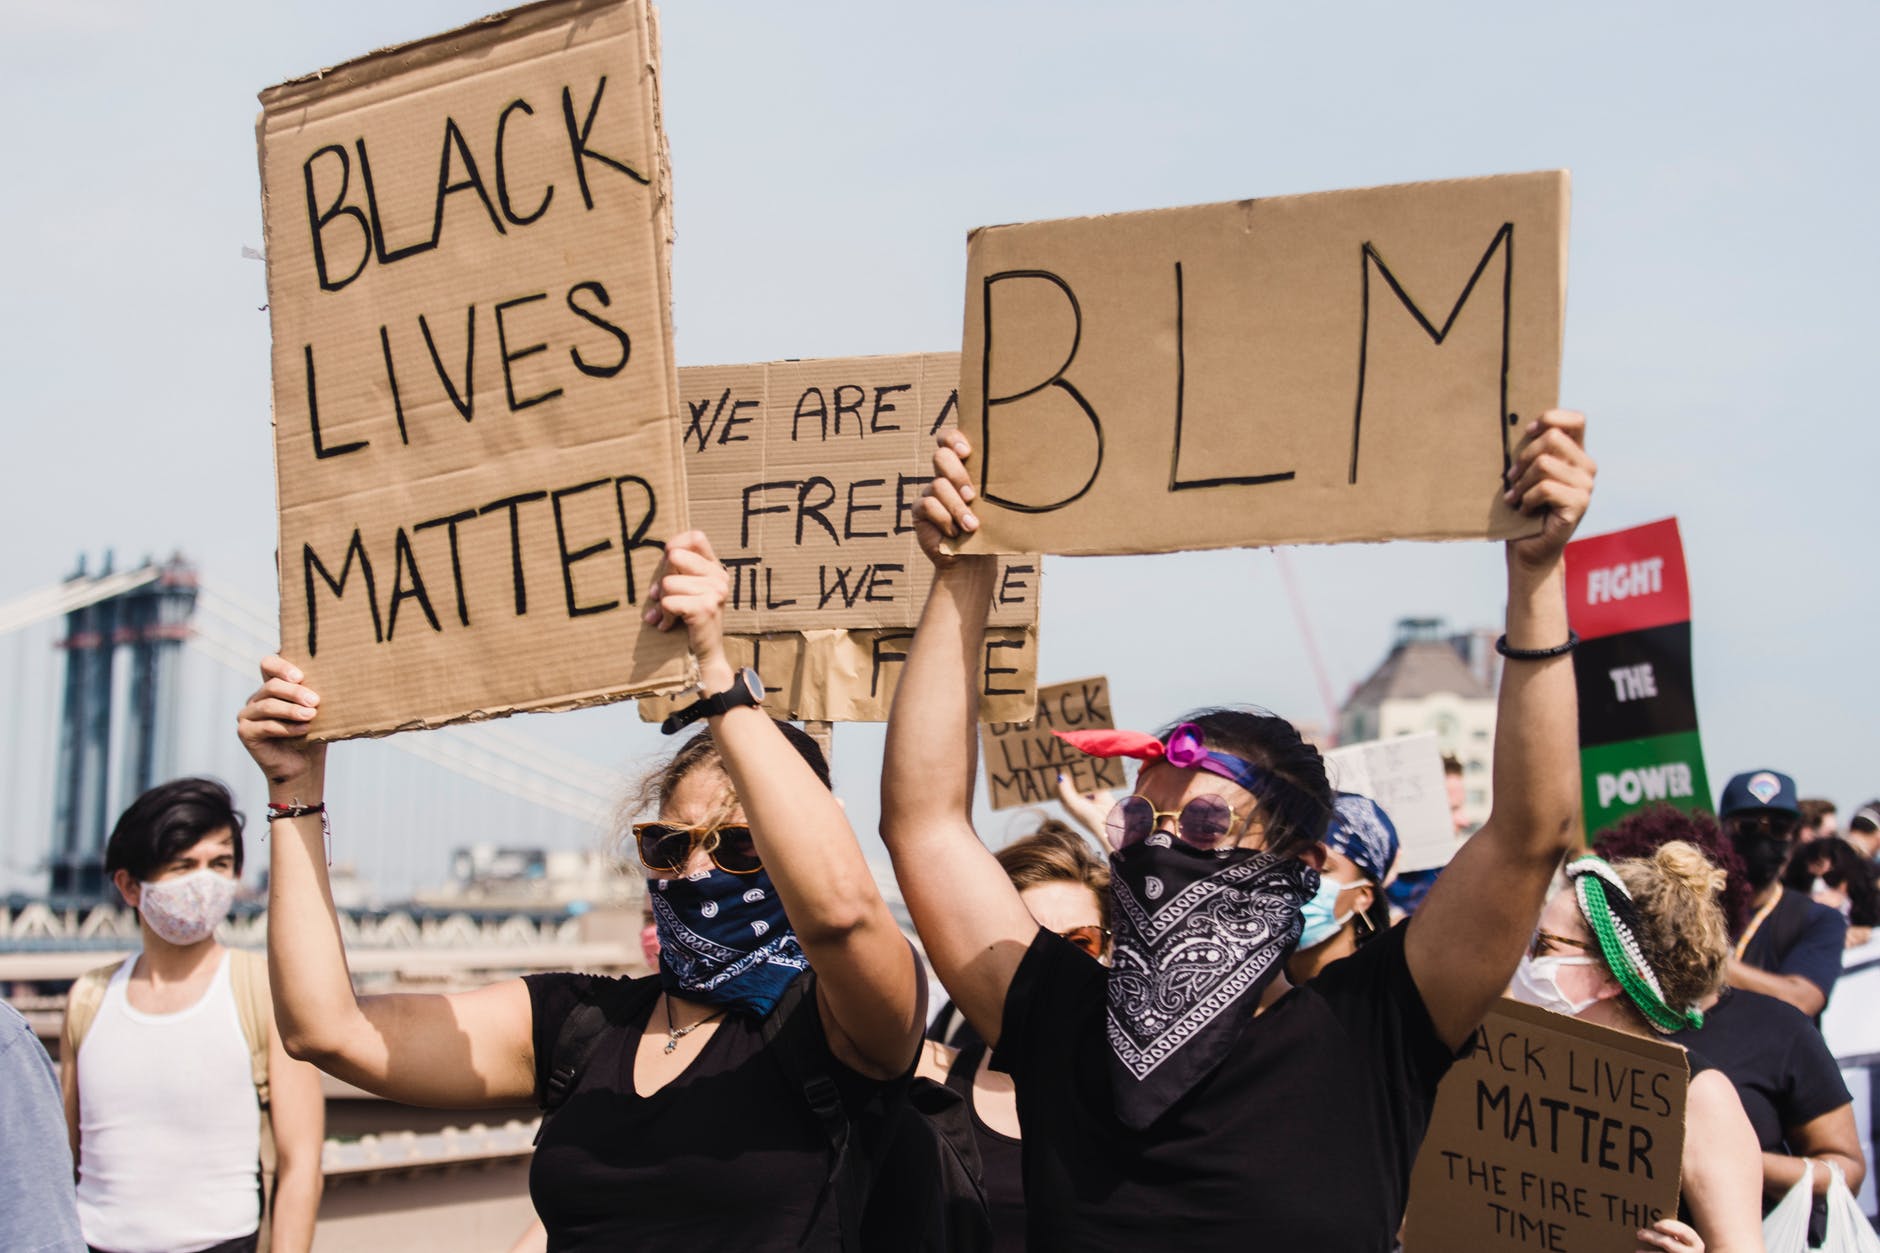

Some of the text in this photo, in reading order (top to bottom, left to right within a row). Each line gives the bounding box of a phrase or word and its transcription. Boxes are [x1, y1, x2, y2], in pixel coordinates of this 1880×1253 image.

[303, 76, 652, 292] BLACK
[305, 281, 631, 459] LIVES
[683, 388, 760, 453] WE
[791, 384, 912, 442] ARE
[740, 472, 937, 548] FREE
[304, 475, 667, 658] MATTER
[720, 557, 904, 611] TIL WE
[1587, 558, 1664, 605] FIGHT
[1610, 663, 1658, 702] THE
[1000, 734, 1096, 772] LIVE
[1596, 762, 1694, 808] POWER
[1472, 1023, 1672, 1118] ACK LIVES
[1476, 1079, 1654, 1180] MATTER
[1440, 1150, 1663, 1230] THE FIRE THIS
[1487, 1202, 1568, 1253] TIME
